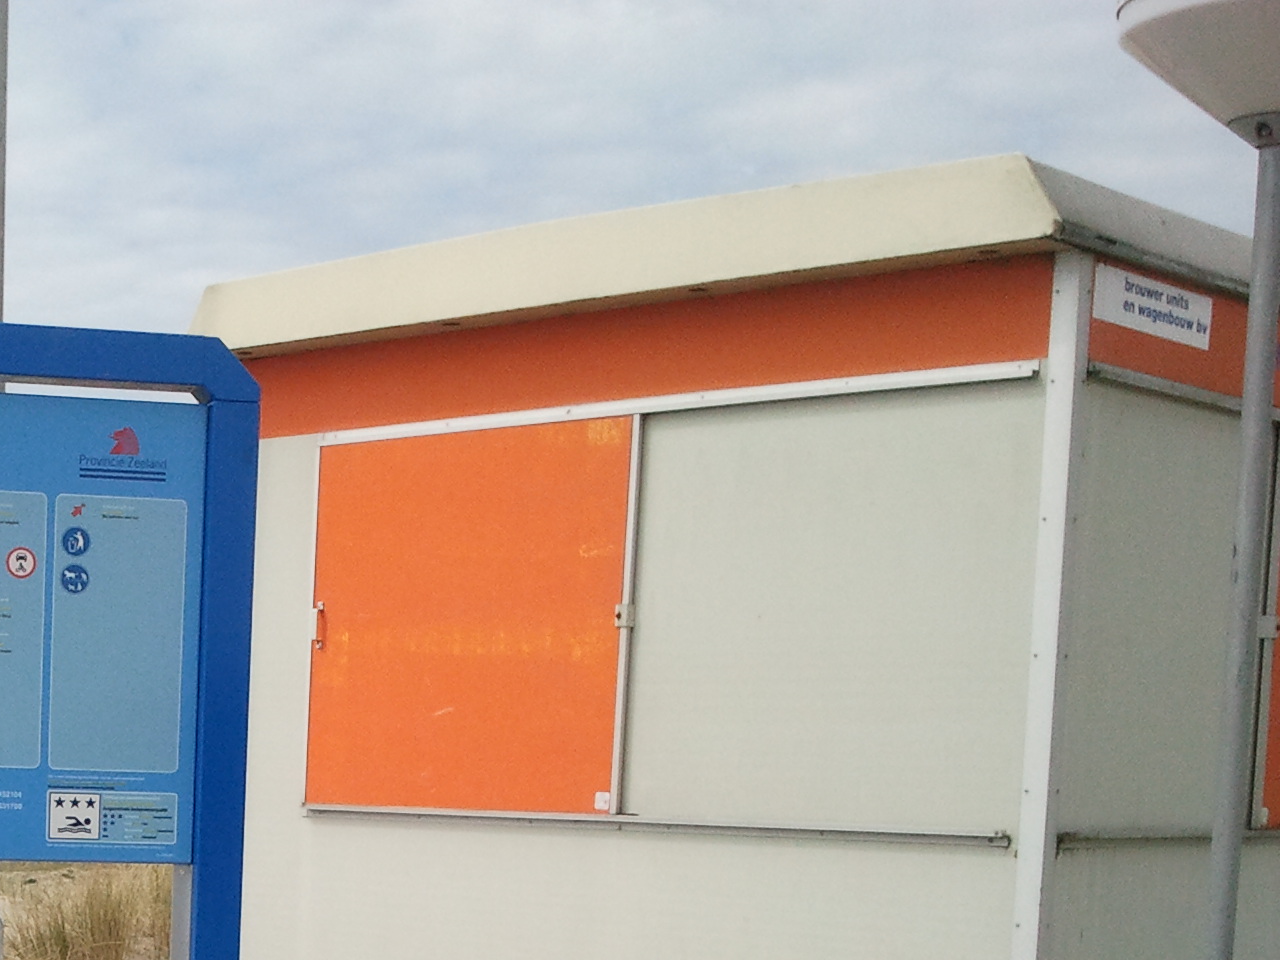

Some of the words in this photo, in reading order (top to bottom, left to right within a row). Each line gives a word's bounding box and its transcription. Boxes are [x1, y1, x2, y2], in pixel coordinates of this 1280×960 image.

[1124, 277, 1165, 302] brouwer
[1166, 292, 1190, 310] units
[1122, 300, 1136, 314] en
[1138, 304, 1195, 331] wagenbouw
[1195, 318, 1208, 335] bv
